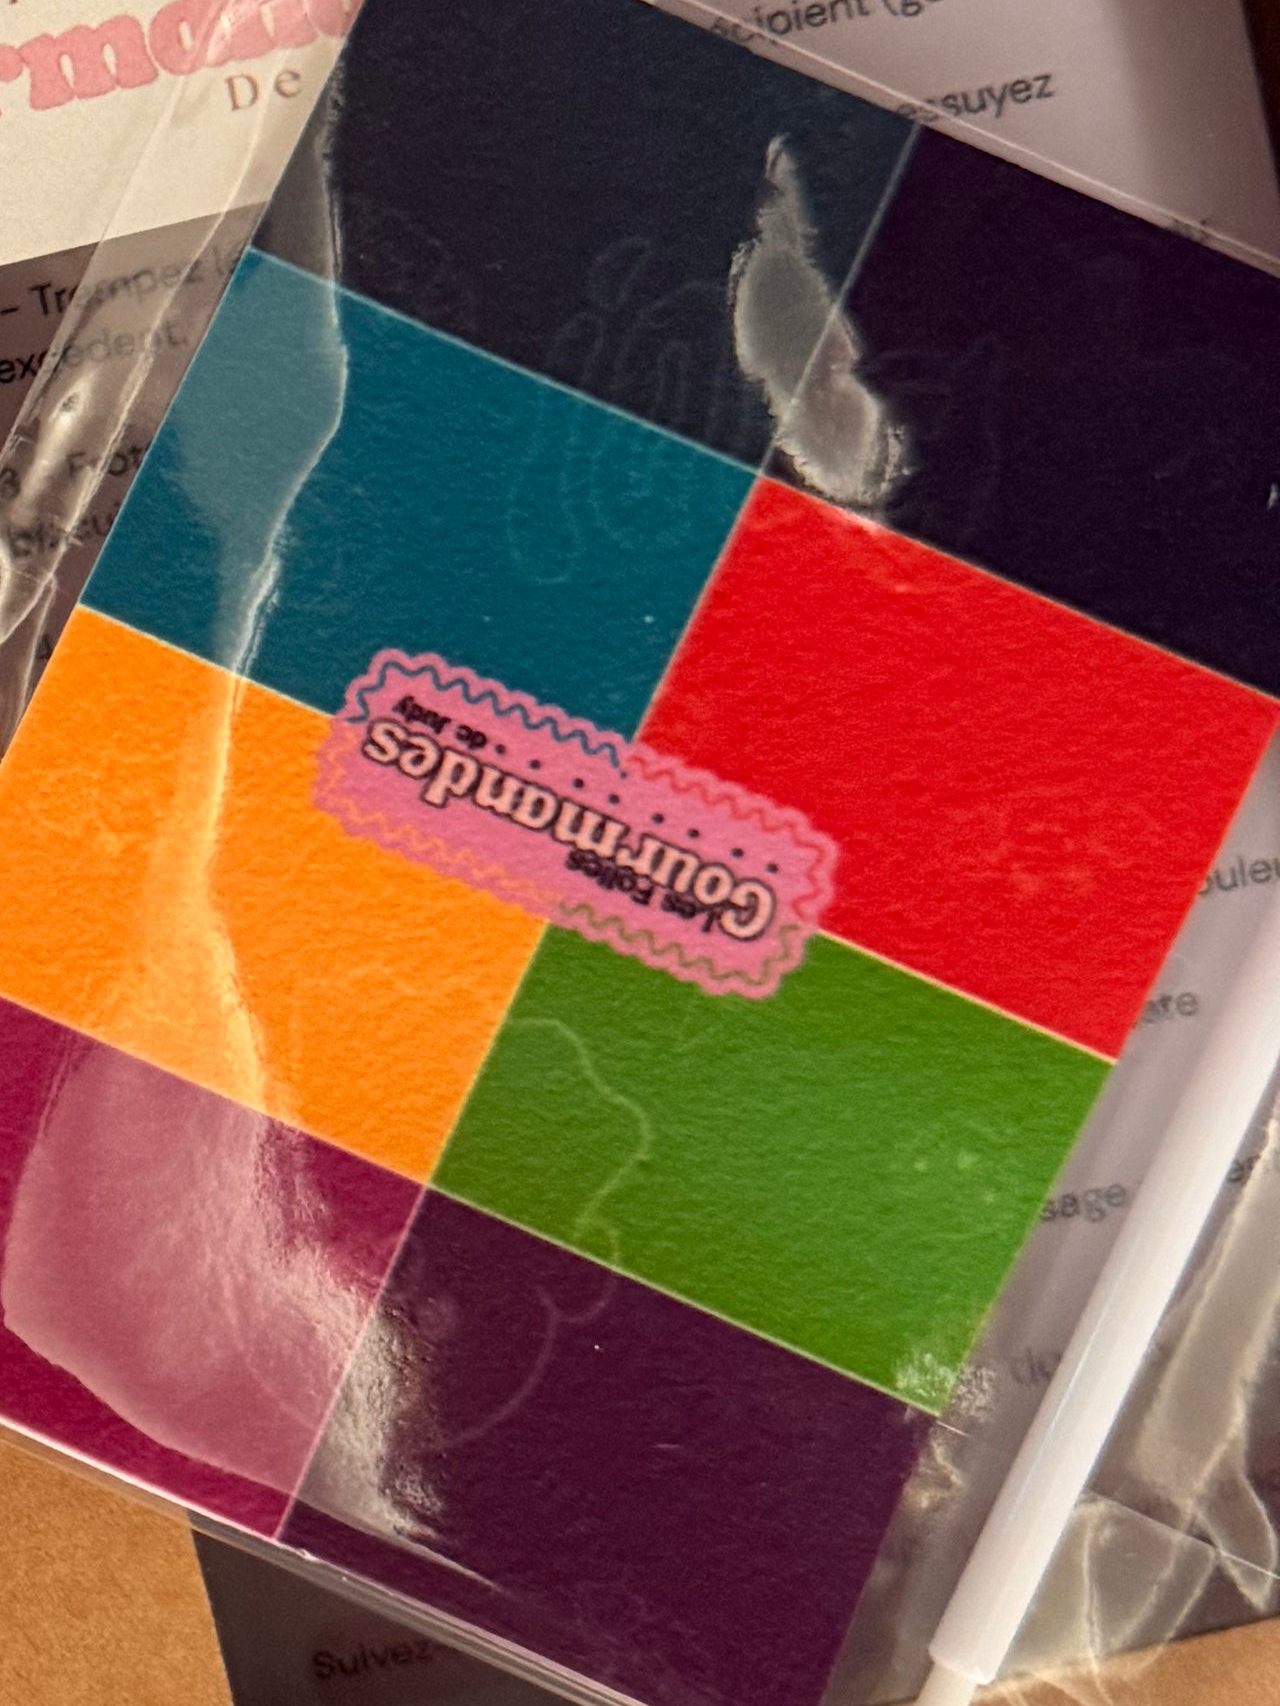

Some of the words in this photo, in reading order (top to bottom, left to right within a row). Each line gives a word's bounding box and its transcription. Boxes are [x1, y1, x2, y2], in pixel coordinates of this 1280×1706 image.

[224, 67, 303, 112] De
[362, 717, 778, 942] Gourmandes
[565, 848, 653, 907] Folies
[661, 889, 721, 933] Les
